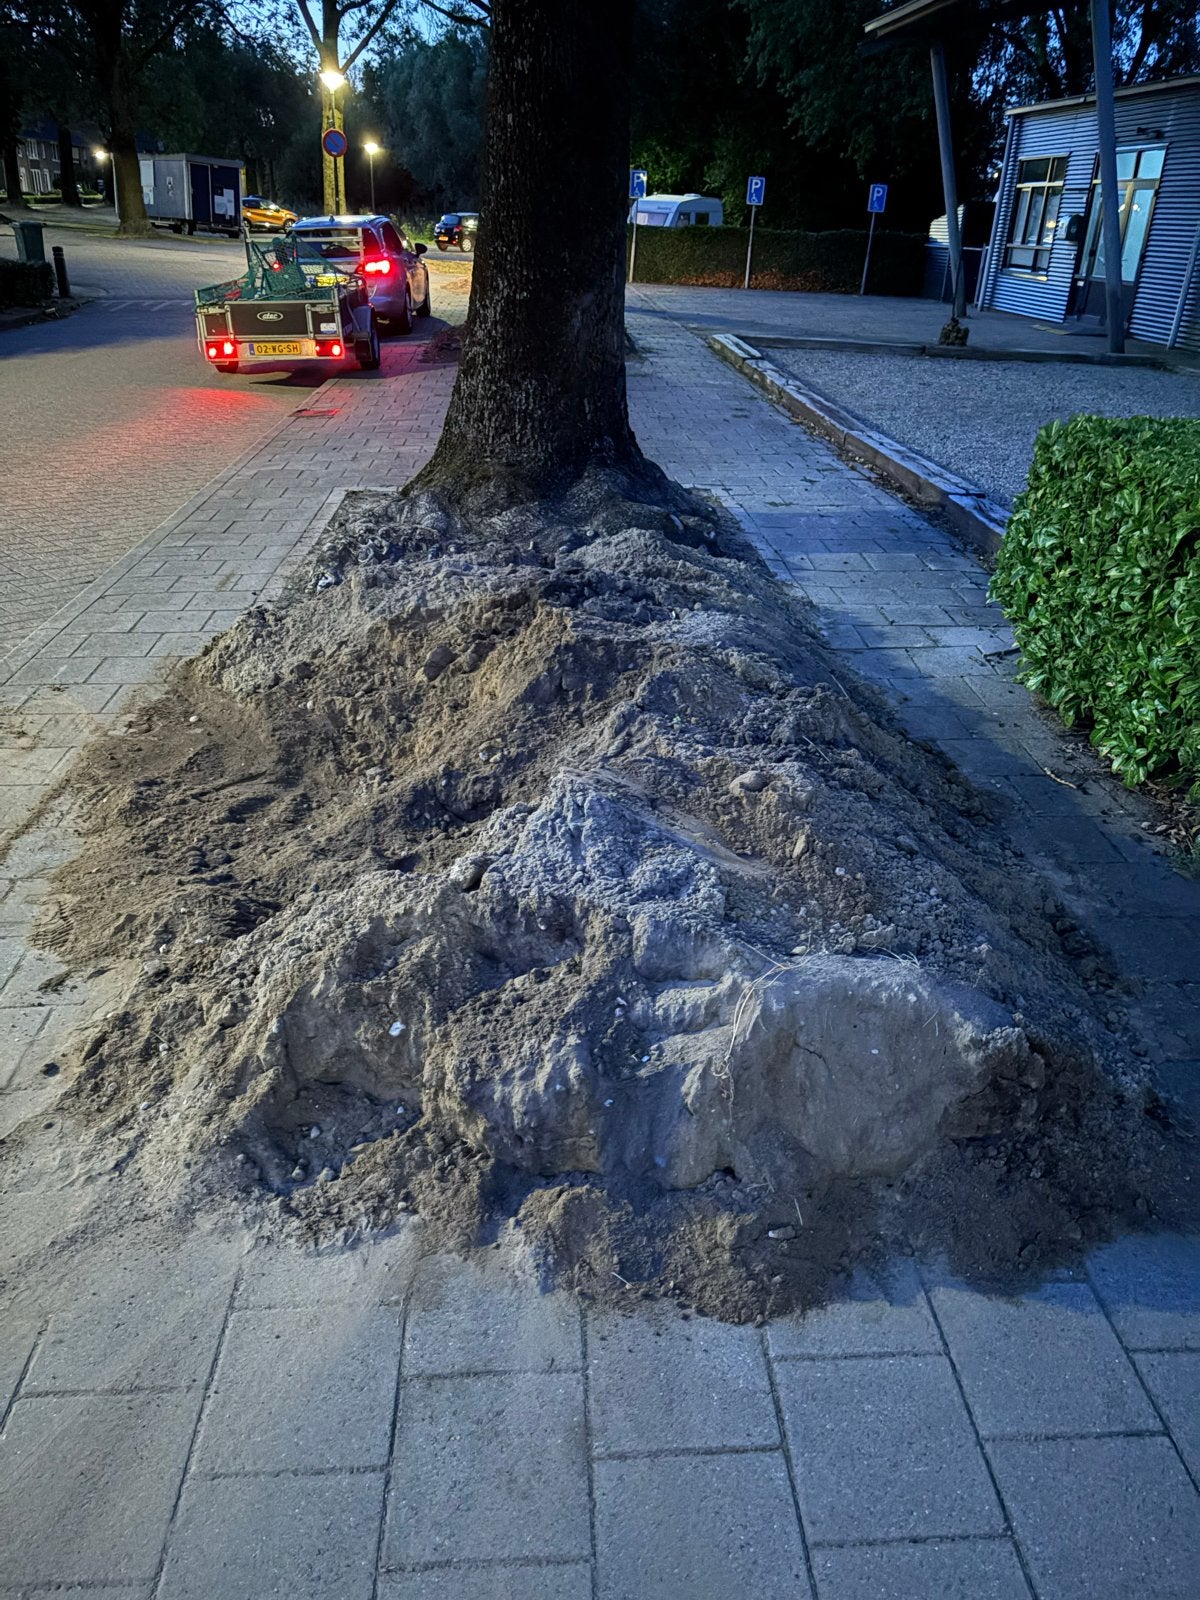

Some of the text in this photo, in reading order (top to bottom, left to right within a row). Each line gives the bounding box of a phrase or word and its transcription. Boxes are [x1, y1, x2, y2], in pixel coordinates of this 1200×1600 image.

[634, 173, 643, 187] P
[751, 179, 761, 193] P
[873, 187, 883, 201] P
